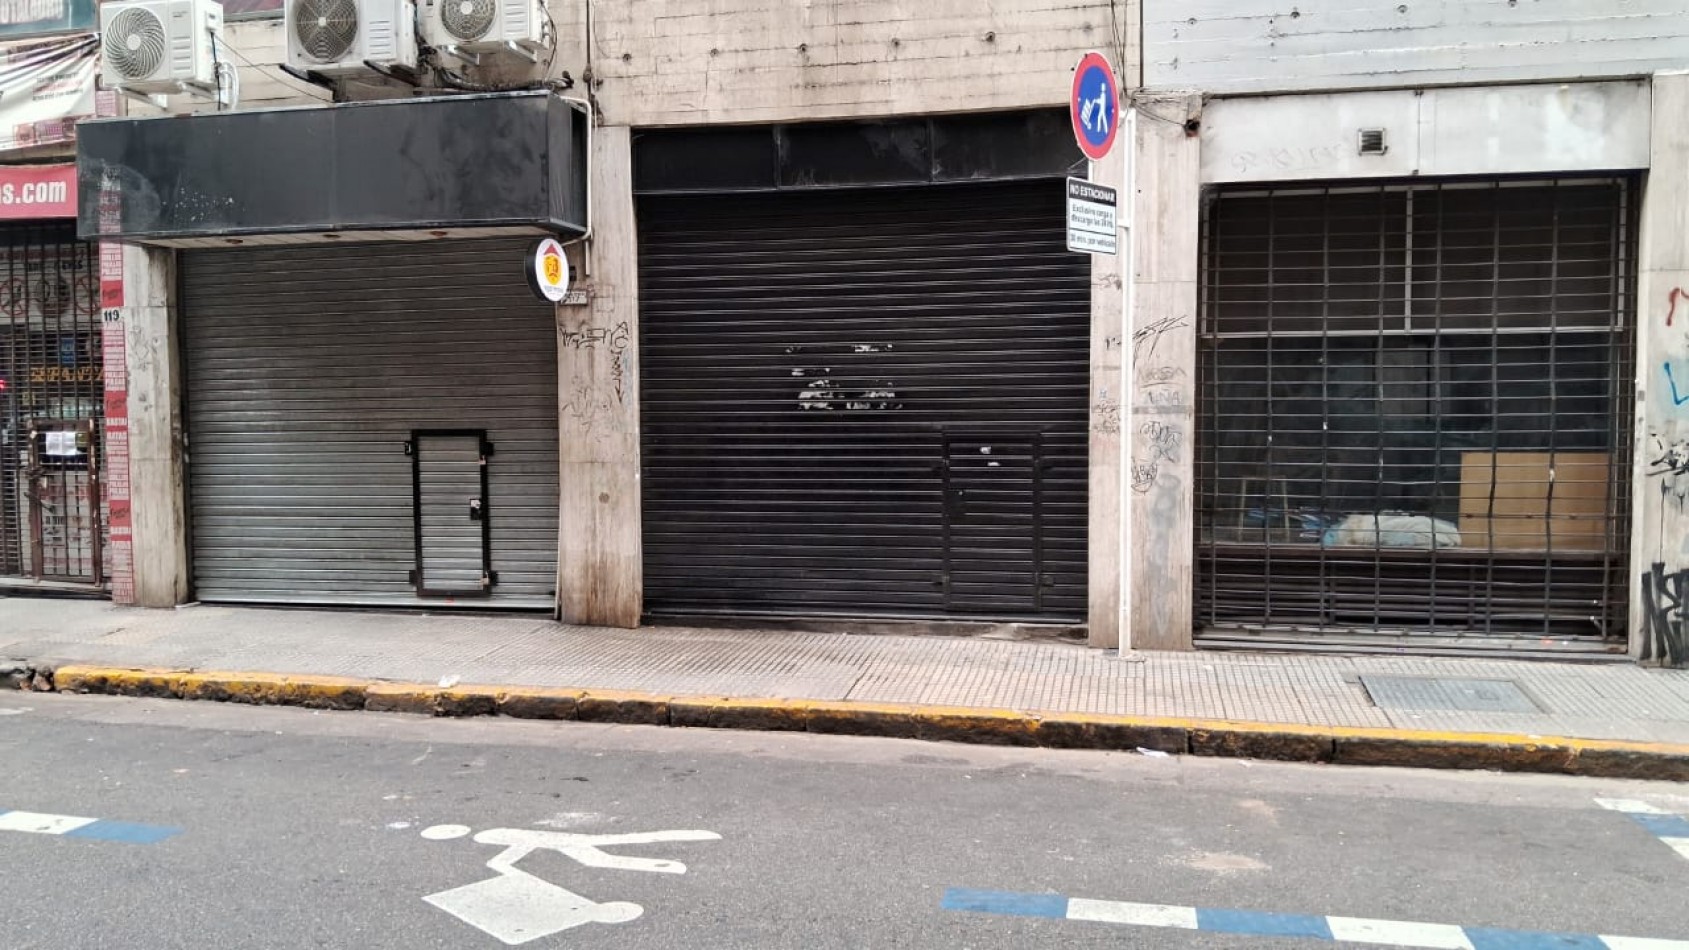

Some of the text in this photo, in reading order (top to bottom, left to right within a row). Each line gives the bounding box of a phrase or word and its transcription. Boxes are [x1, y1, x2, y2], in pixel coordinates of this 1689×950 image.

[0, 181, 67, 204] s.com
[1070, 184, 1115, 202] NO ESTACIONAR
[103, 309, 120, 322] 119
